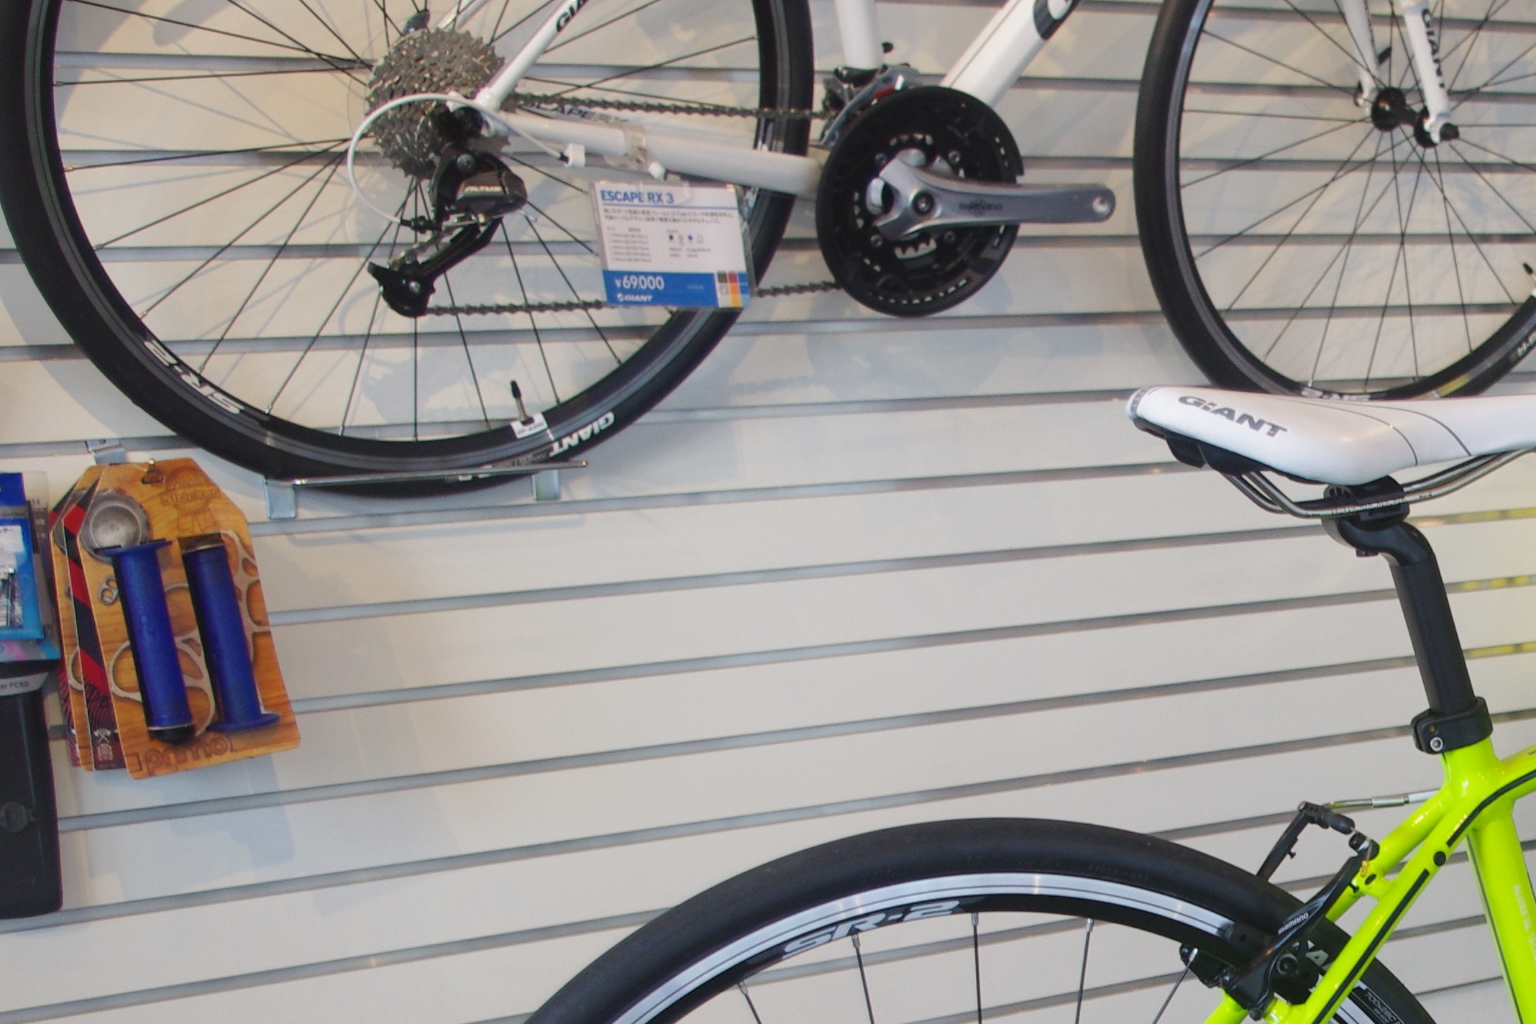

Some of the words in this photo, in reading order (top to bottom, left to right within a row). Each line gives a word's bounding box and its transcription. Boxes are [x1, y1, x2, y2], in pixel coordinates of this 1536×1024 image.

[647, 191, 664, 204] RX
[666, 192, 675, 204] 3
[143, 339, 246, 416] SR-2
[549, 410, 616, 458] GIANT
[1178, 395, 1289, 438] GIANT
[781, 899, 961, 961] SR-2
[1277, 912, 1309, 936] SHIMANO
